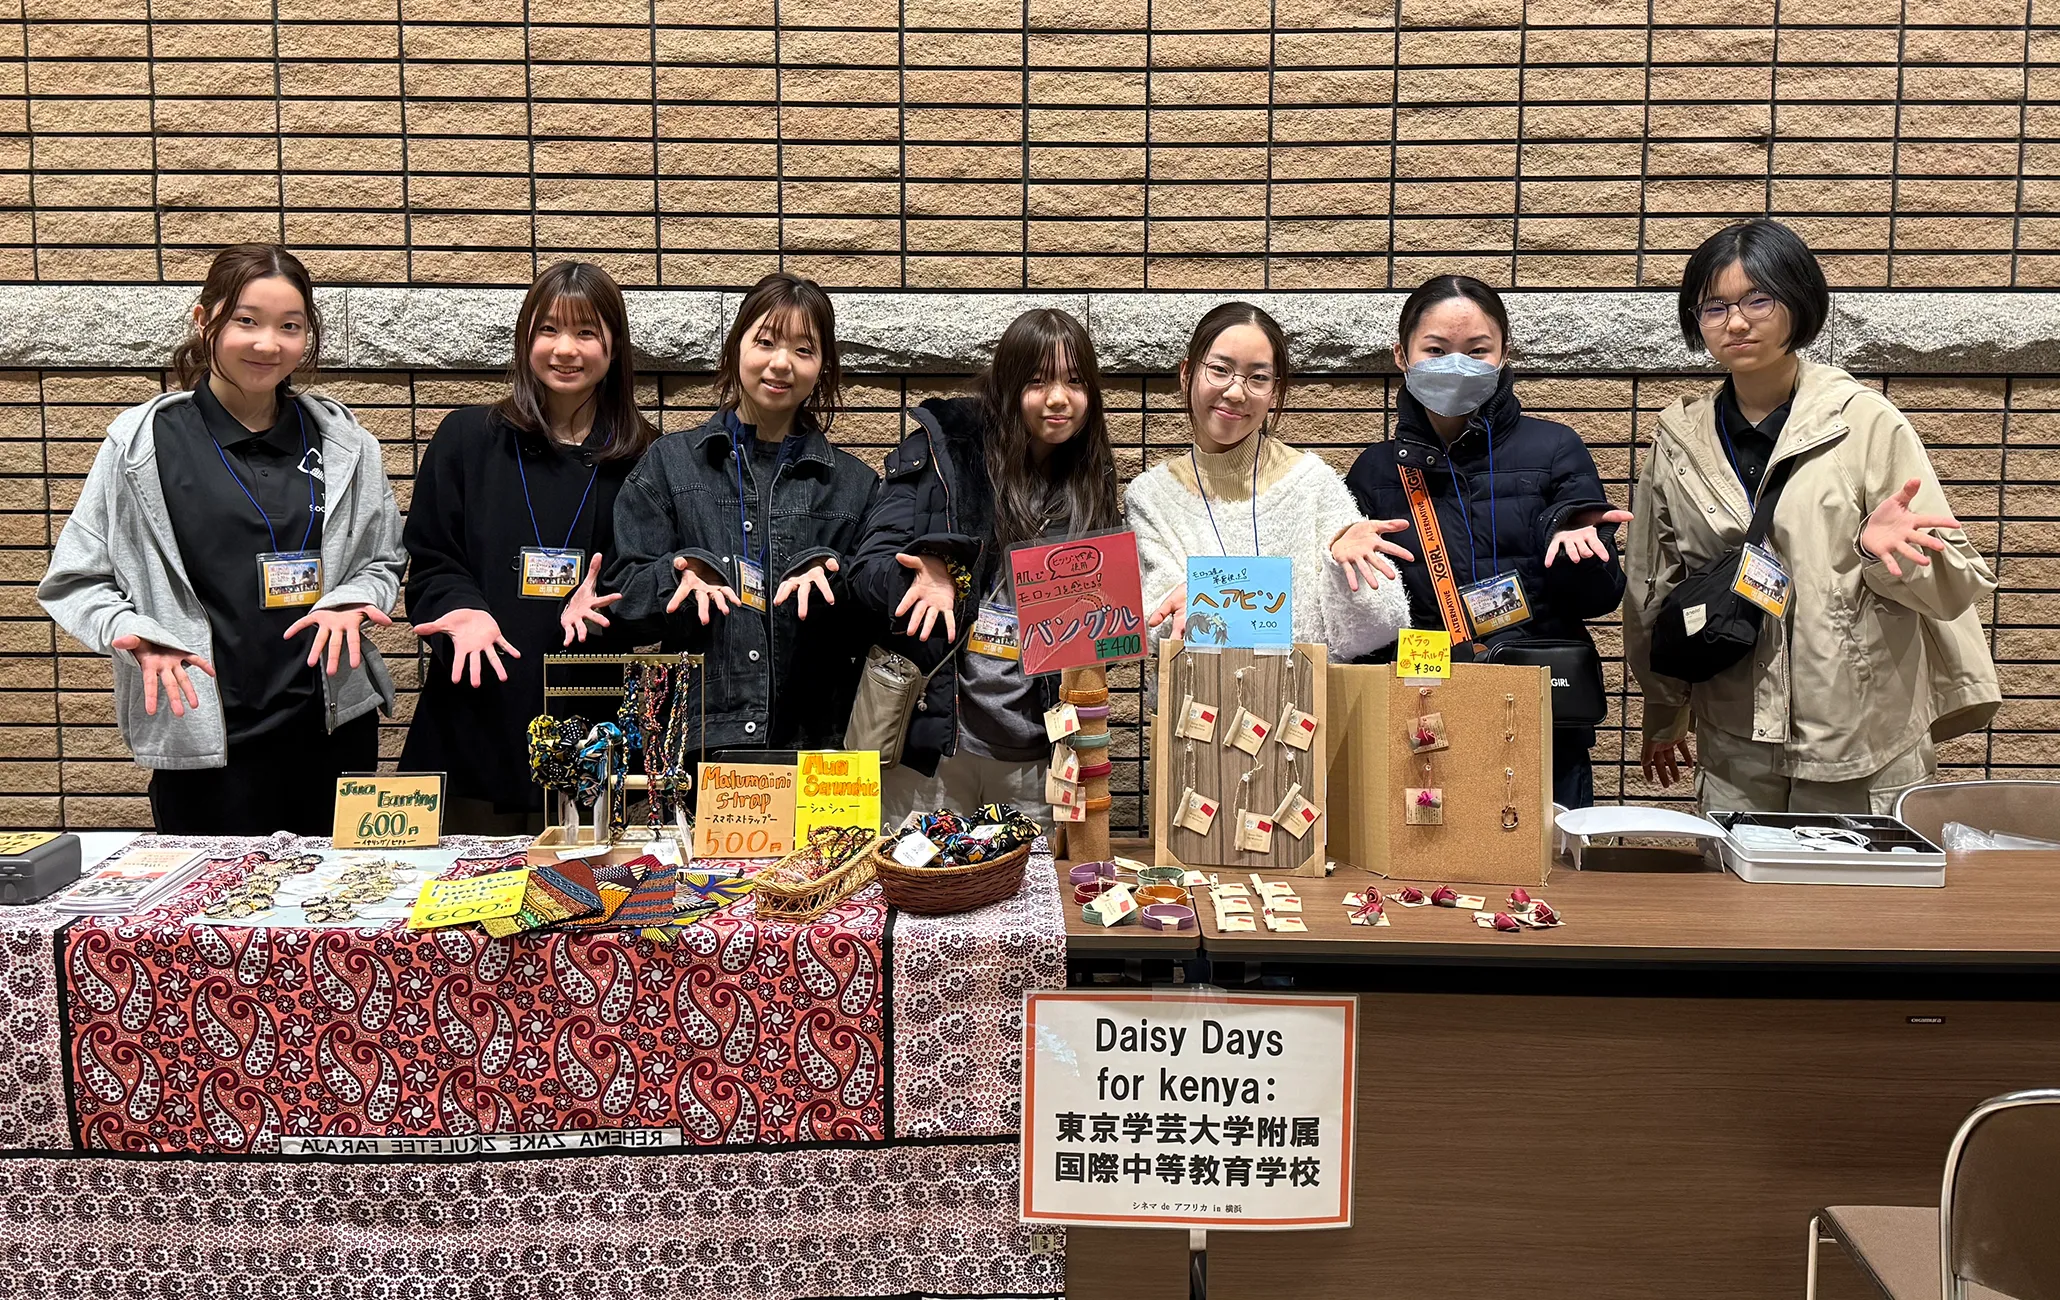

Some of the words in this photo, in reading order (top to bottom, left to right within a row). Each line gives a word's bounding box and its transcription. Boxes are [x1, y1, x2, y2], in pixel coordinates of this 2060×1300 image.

[1404, 466, 1423, 495] XGIR
[1417, 501, 1435, 542] ALTERNATIVE
[1429, 544, 1448, 583] XGIRL
[1016, 570, 1044, 584] 肌で
[1191, 588, 1287, 614] ヘアピン
[1444, 590, 1462, 634] ALTERNATIVE
[1022, 605, 1140, 651] バングル
[1250, 619, 1278, 631] ¥200
[1096, 634, 1140, 657] ¥400
[1402, 634, 1430, 647] バラの
[1409, 648, 1450, 661] キーホルダー
[1413, 662, 1442, 675] ¥300
[1550, 677, 1571, 687] GIRL
[802, 753, 849, 776] Mua
[810, 803, 845, 814] シュシュ
[357, 811, 419, 838] 600円
[700, 828, 782, 857] 500円
[1095, 1018, 1187, 1057] Daisy
[1202, 1020, 1284, 1060] Days
[1097, 1066, 1145, 1101] for
[1160, 1067, 1277, 1107] kenya:
[1055, 1111, 1321, 1148] 東京学芸大学附属
[1054, 1151, 1321, 1188] 国際中等教育学校
[1132, 1201, 1157, 1210] シネマ
[1160, 1202, 1171, 1210] de
[1174, 1203, 1208, 1212] アフリカ
[1212, 1204, 1221, 1212] in
[1225, 1204, 1242, 1213] 横浜
